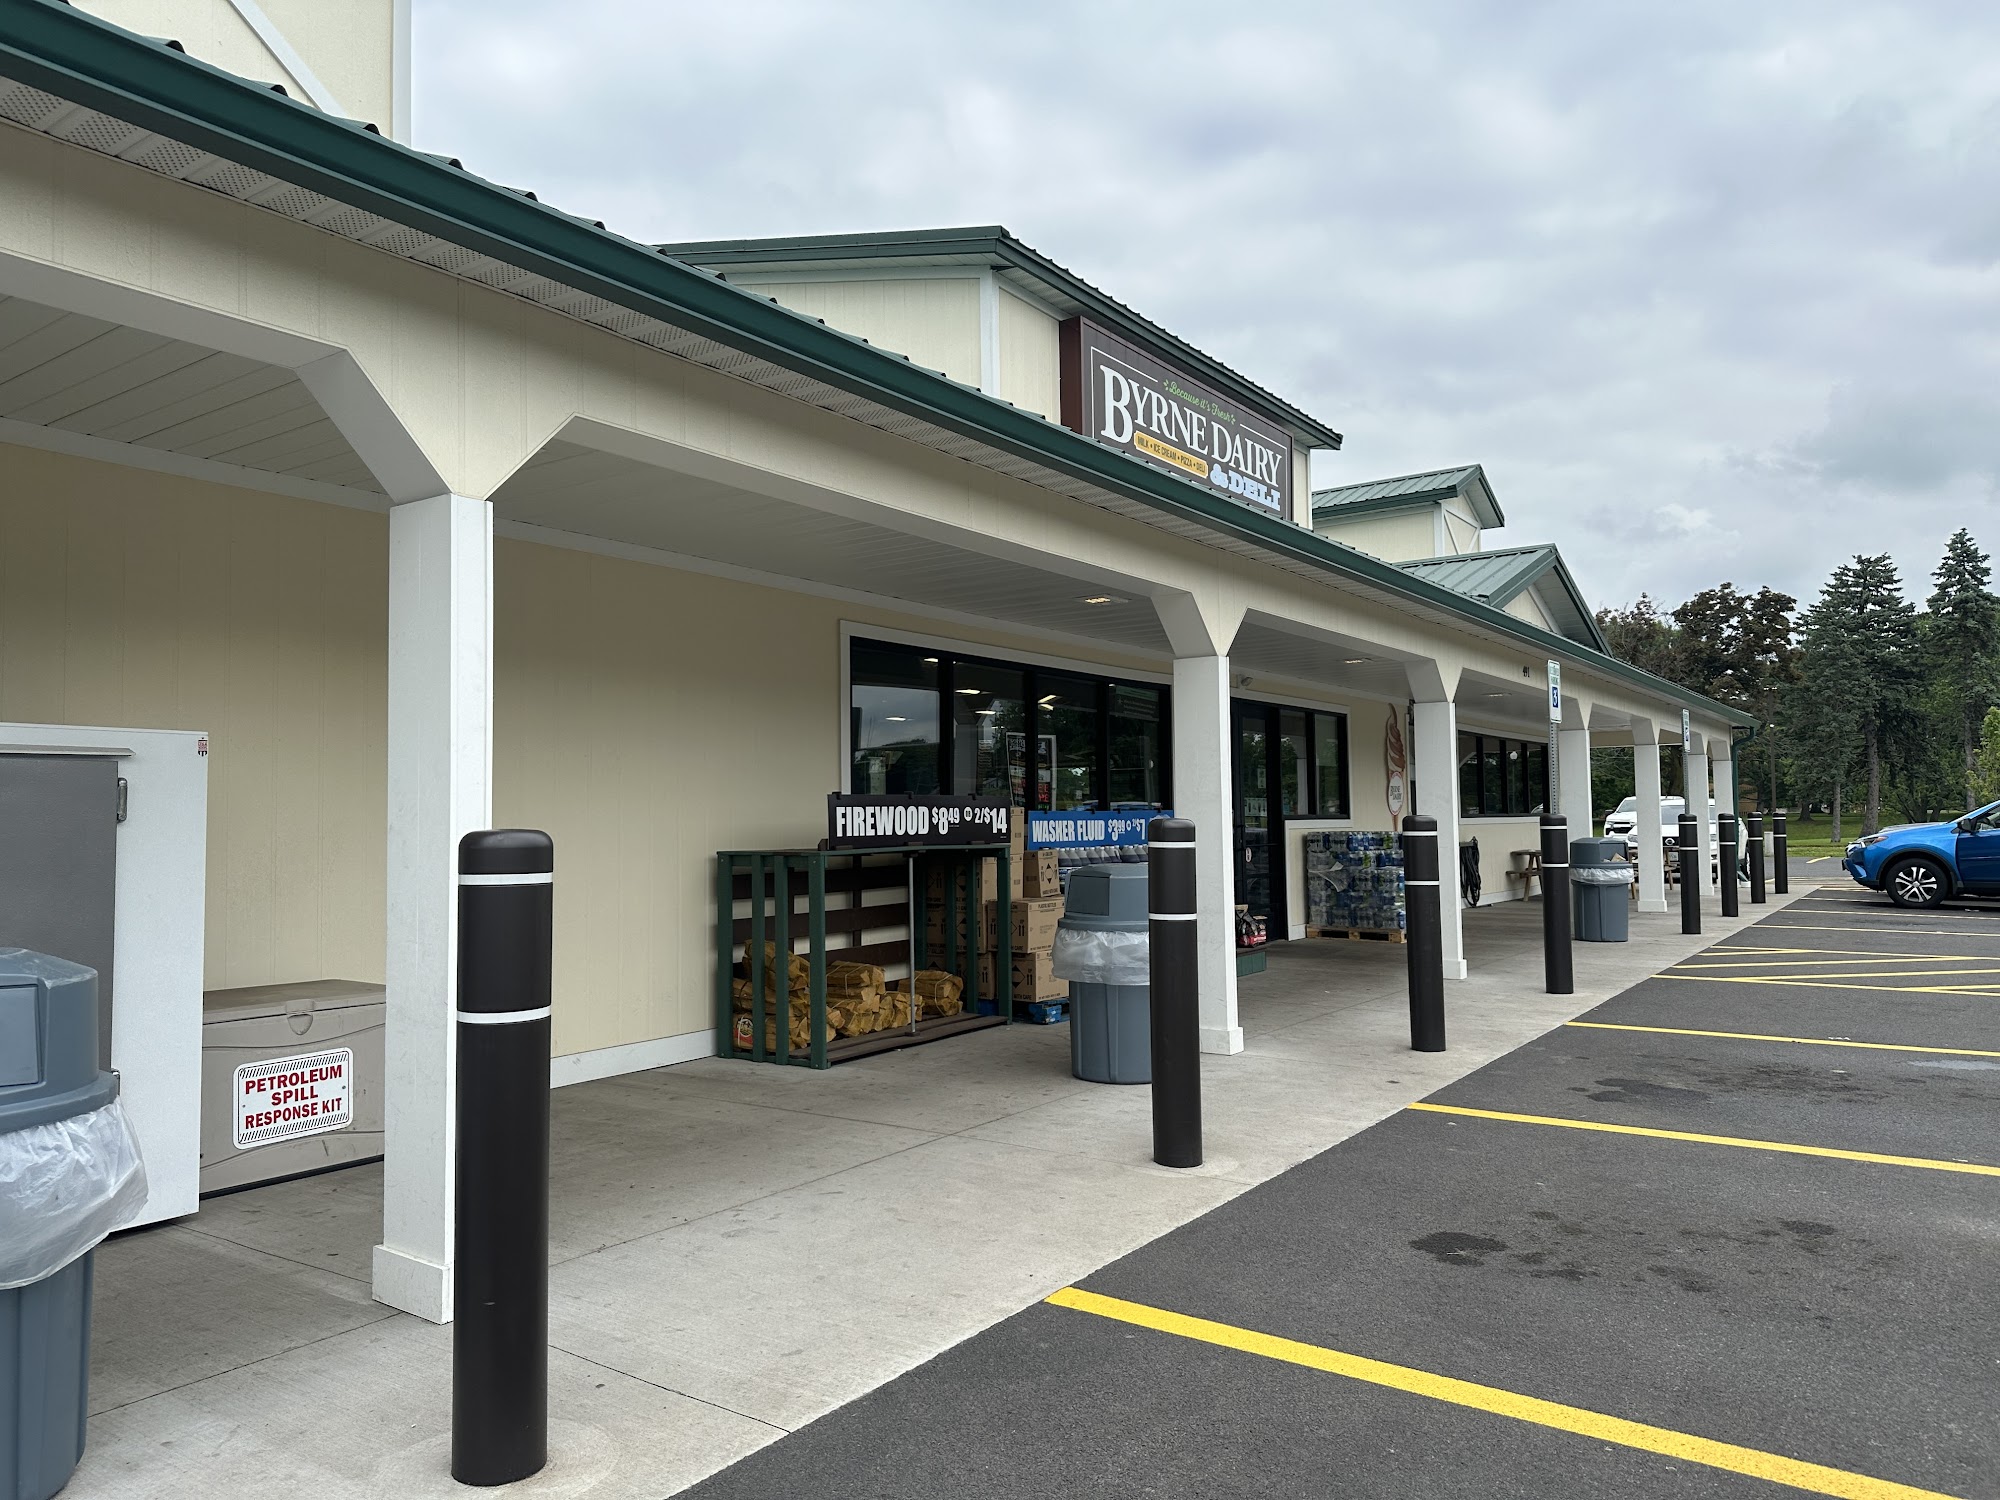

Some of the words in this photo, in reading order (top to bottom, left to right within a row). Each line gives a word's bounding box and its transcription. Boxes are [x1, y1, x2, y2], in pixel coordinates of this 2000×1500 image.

[1169, 381, 1200, 406] Because
[1211, 403, 1230, 422] Fresh
[1100, 365, 1208, 455] BYRNE
[1211, 421, 1282, 487] DAIRY
[1137, 435, 1149, 448] MILK
[1153, 443, 1161, 454] ICE
[1161, 446, 1177, 461] CREAM
[1181, 455, 1193, 467] PIZZA
[1196, 462, 1206, 473] DELI
[1210, 463, 1228, 489] &
[1229, 470, 1281, 511] DELI
[835, 806, 930, 837] FIREWOOD
[1032, 820, 1075, 842] WASHER
[1077, 820, 1105, 841] FLUID
[245, 1065, 342, 1095] PETROLEUM
[271, 1085, 319, 1106] SPILL
[245, 1102, 318, 1129] RESPONSE
[322, 1098, 342, 1114] KIT
